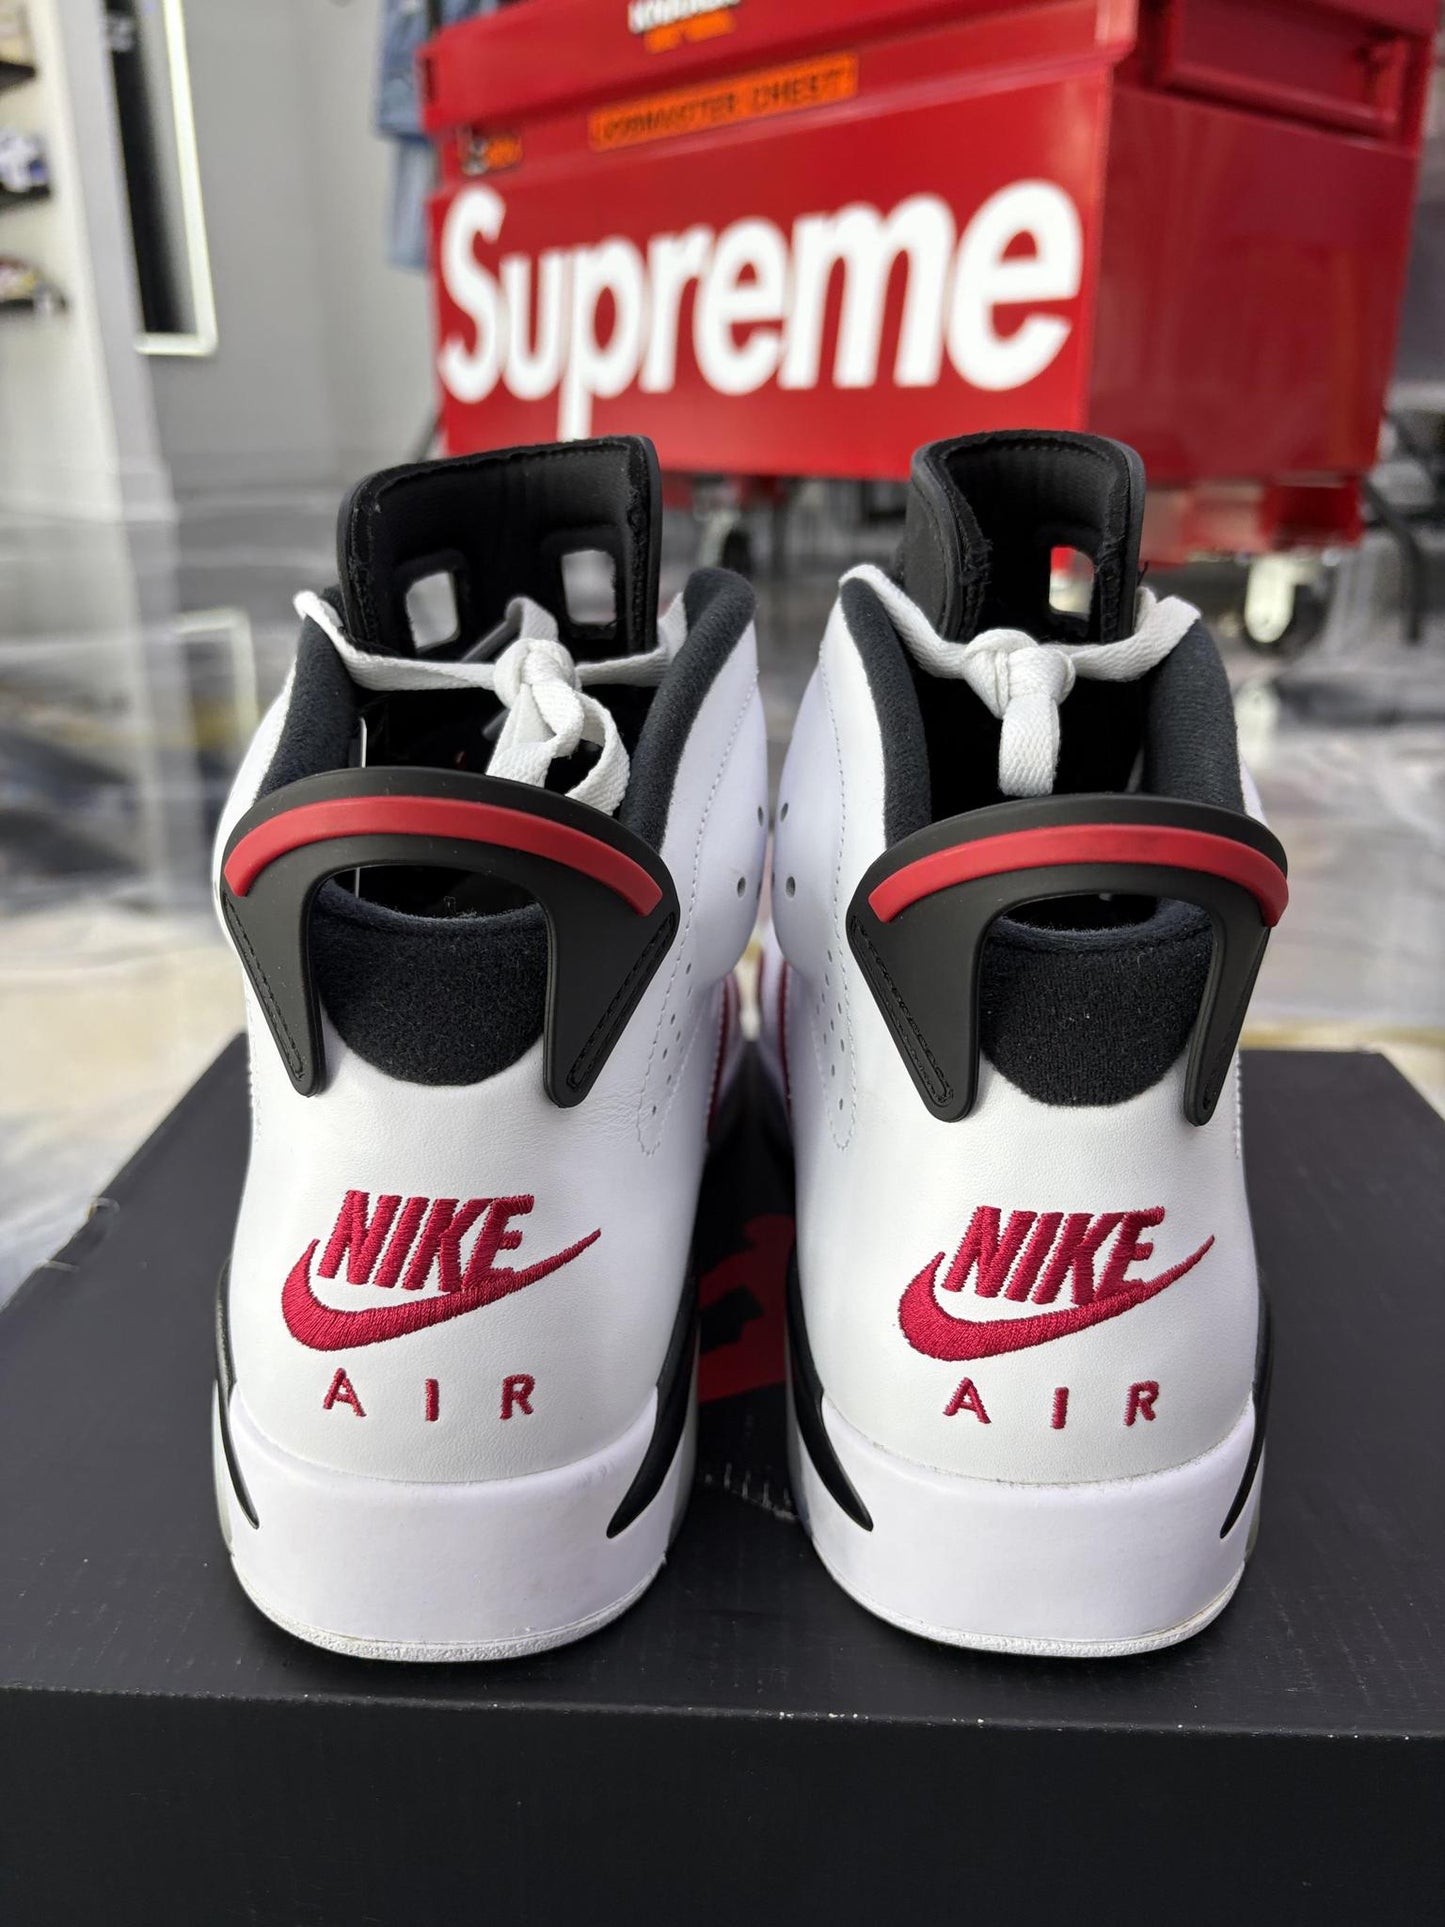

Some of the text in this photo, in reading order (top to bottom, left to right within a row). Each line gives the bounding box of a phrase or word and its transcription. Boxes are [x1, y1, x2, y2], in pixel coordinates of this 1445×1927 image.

[438, 179, 1084, 440] Supreme
[317, 1190, 534, 1292] NIKE
[942, 1206, 1165, 1306] NIKE
[323, 1368, 536, 1421] AIR
[943, 1377, 1159, 1429] AIR
